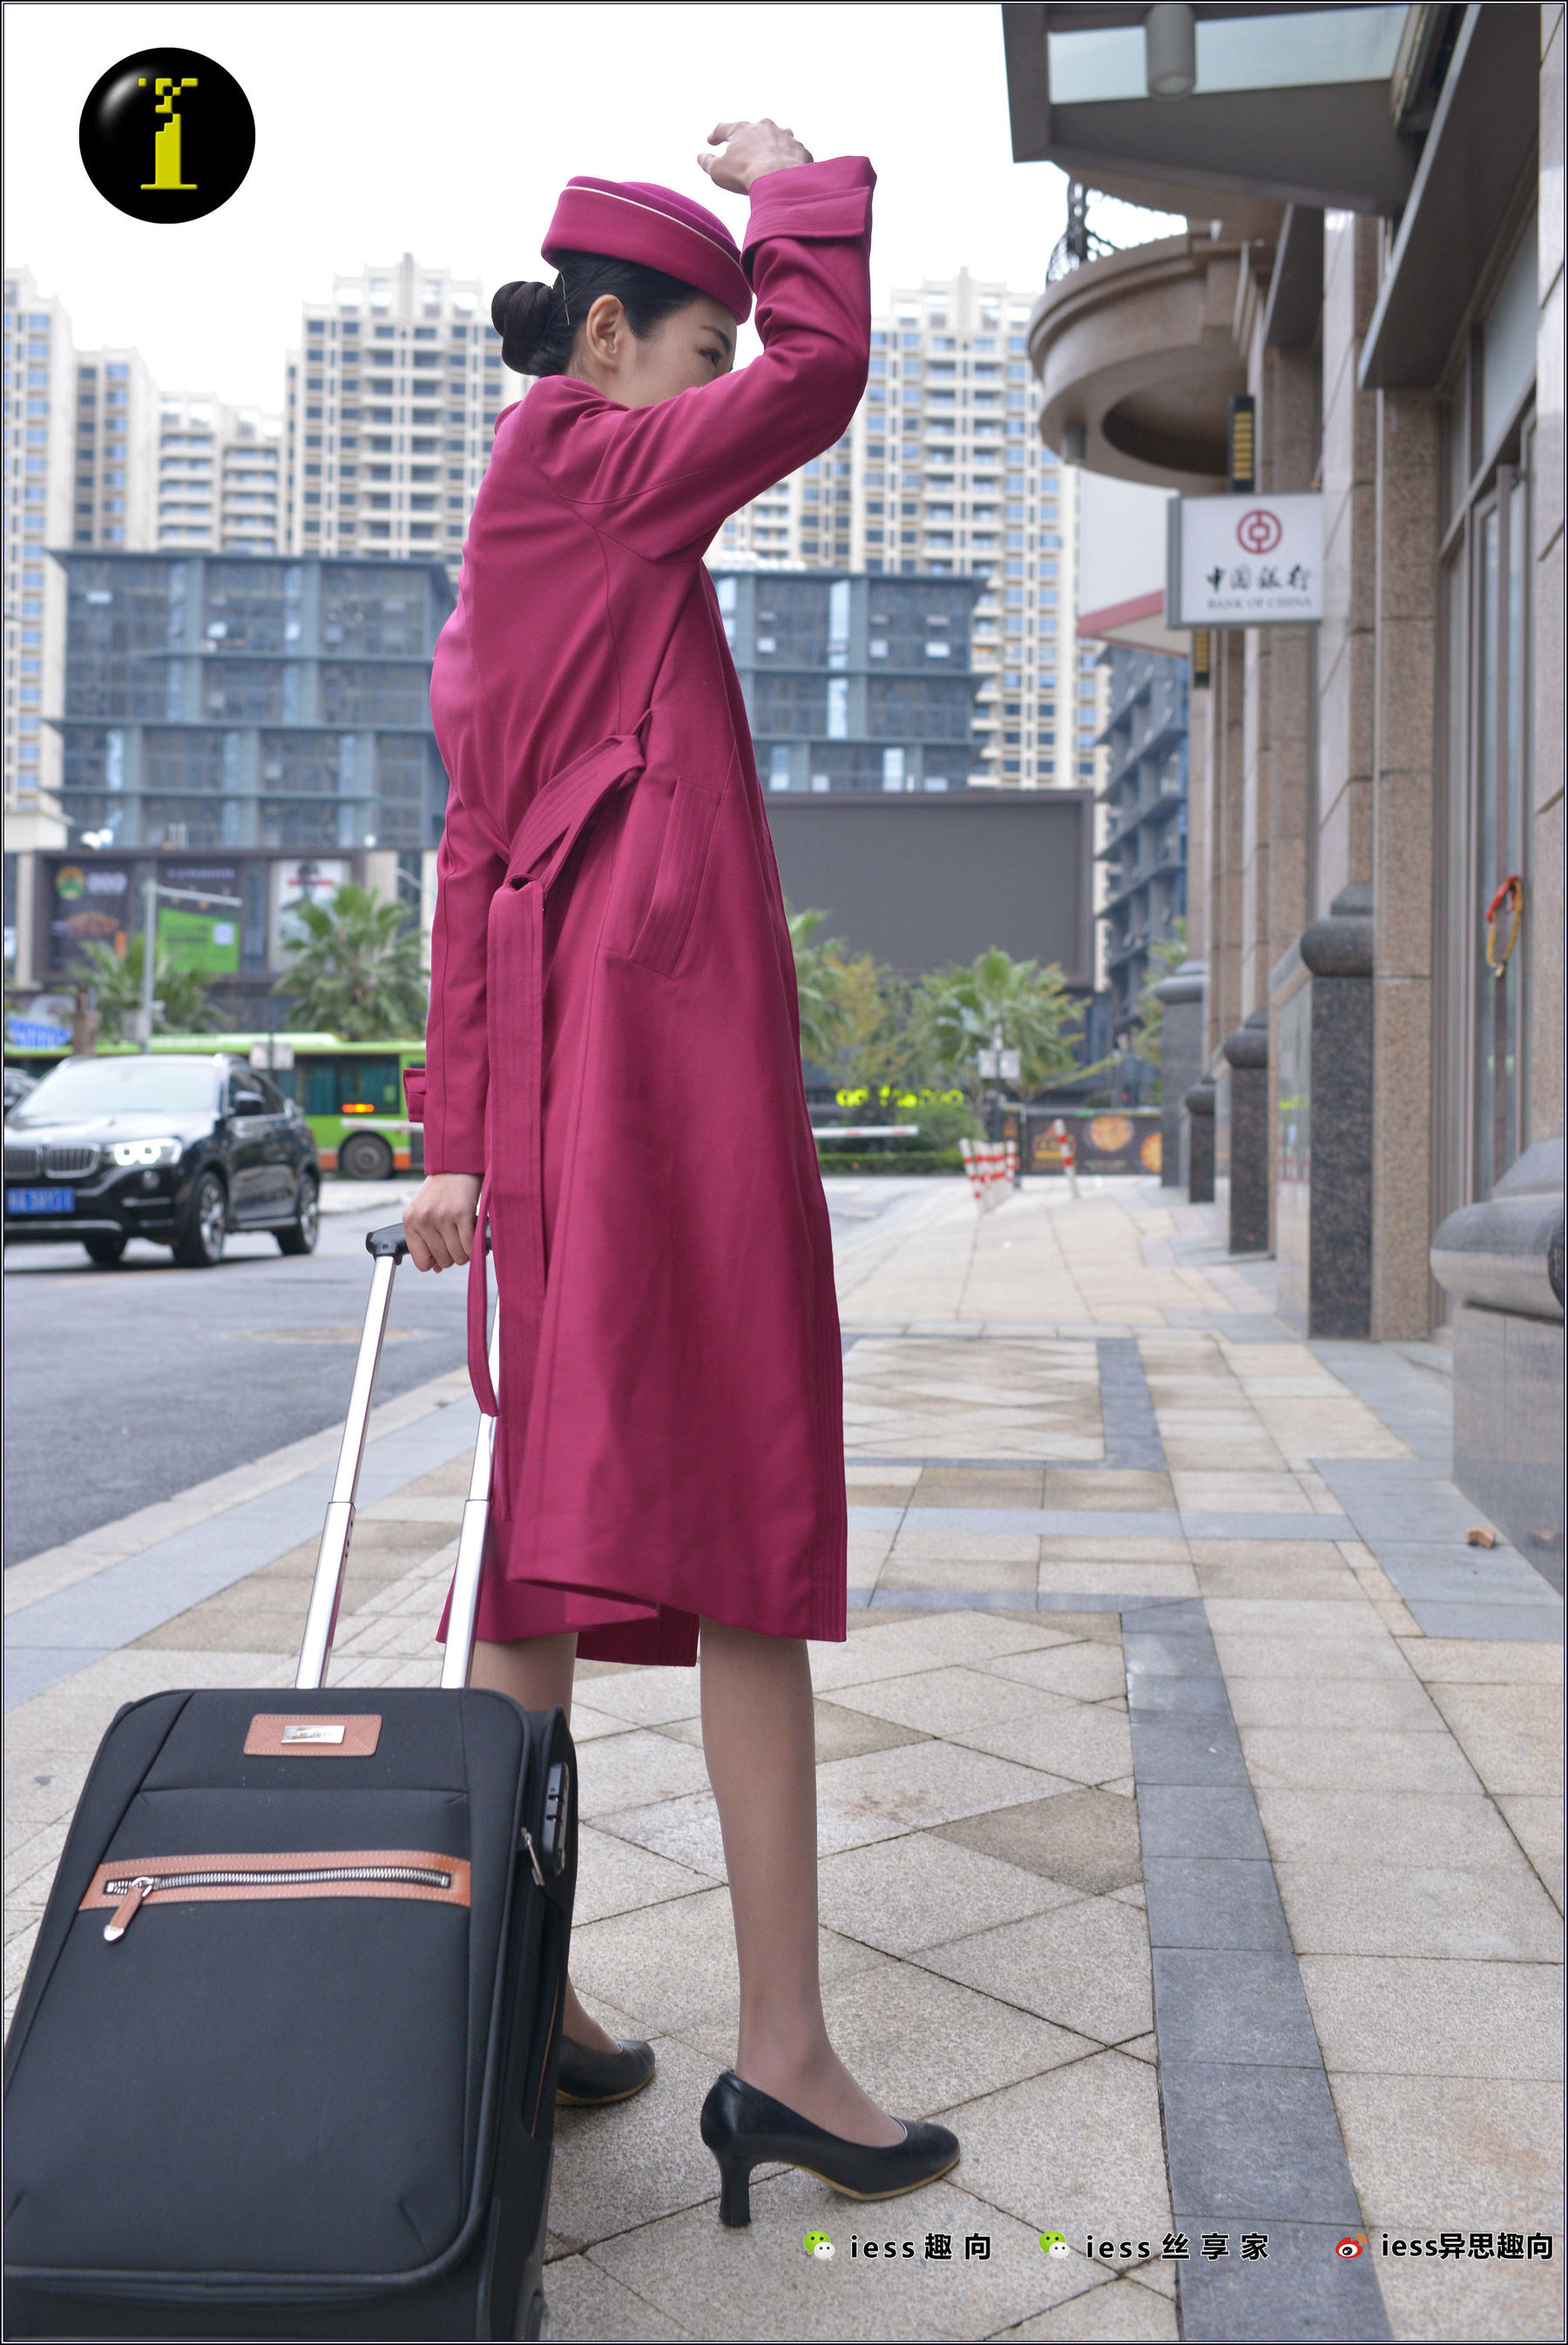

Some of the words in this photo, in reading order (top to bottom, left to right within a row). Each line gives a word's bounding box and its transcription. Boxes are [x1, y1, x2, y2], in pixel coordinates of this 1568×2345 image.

[1206, 564, 1313, 594] 中国银行
[1207, 598, 1244, 610] BANK
[1247, 598, 1265, 609] OF
[1267, 597, 1314, 608] CHINA
